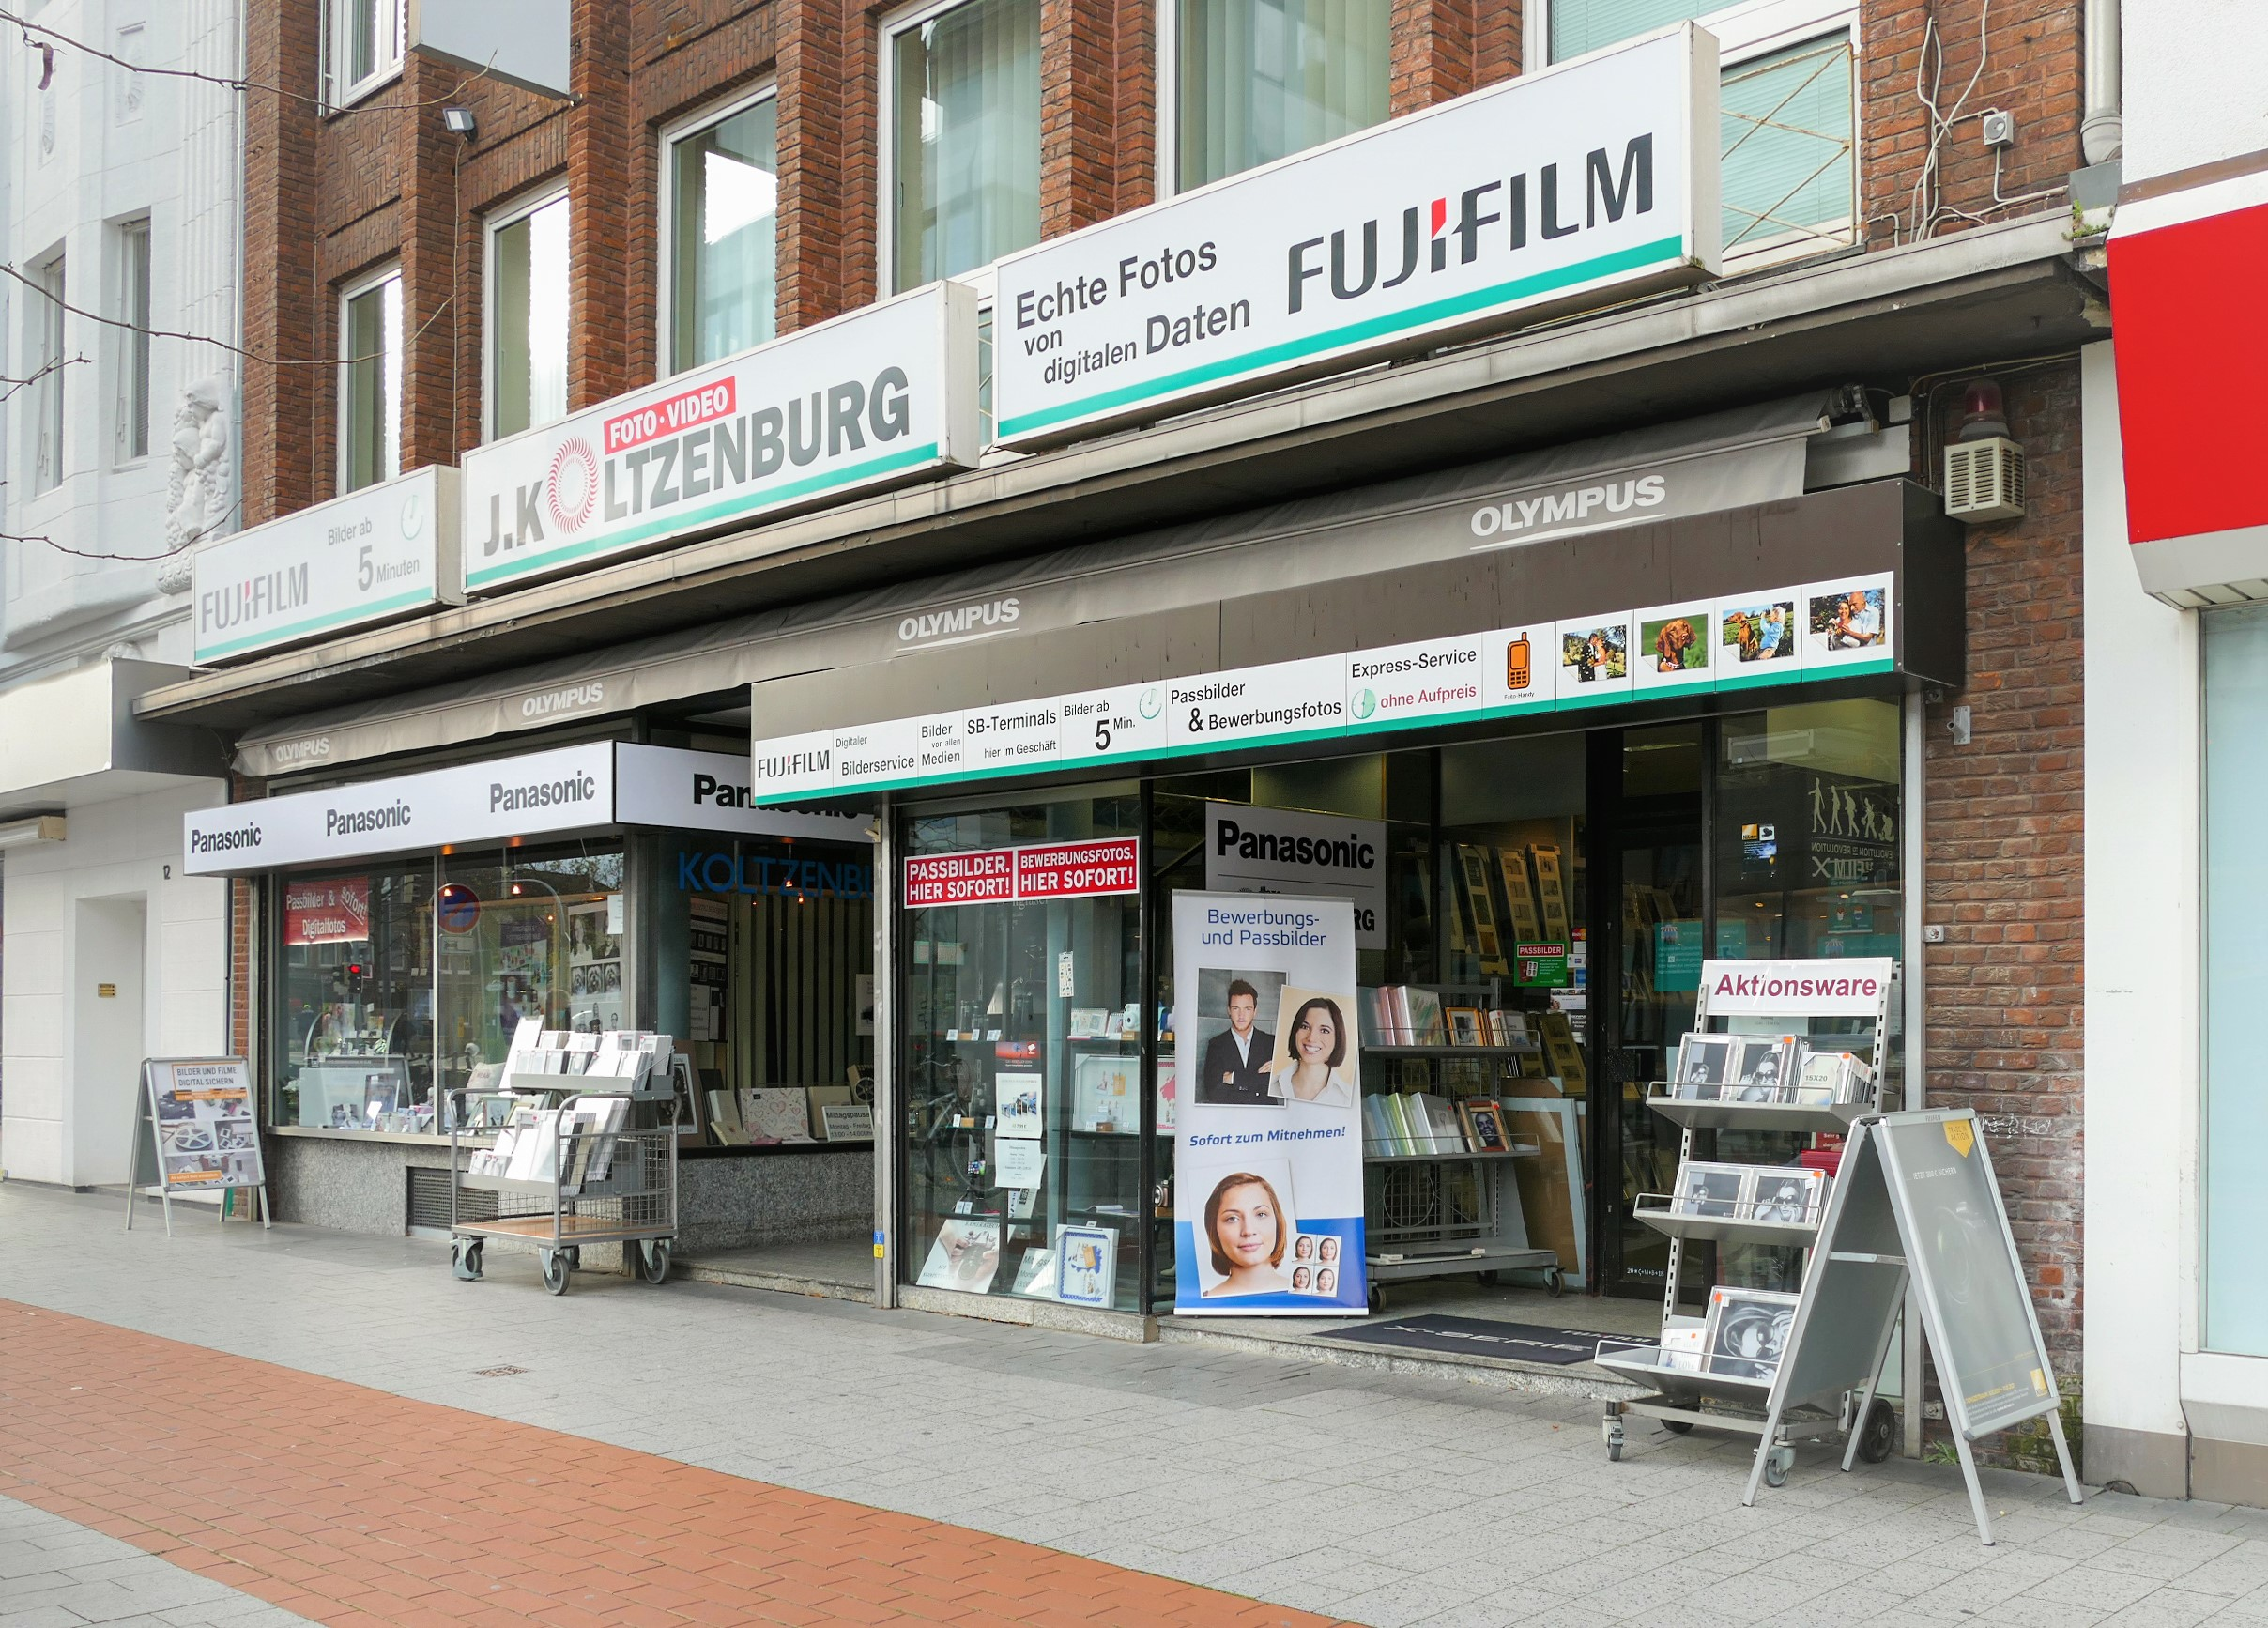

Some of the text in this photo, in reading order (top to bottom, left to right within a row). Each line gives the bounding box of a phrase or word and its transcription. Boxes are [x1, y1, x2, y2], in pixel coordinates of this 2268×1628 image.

[1288, 132, 1653, 315] FUJIFILM
[1017, 242, 1217, 330] Echte Fotos
[1024, 330, 1062, 356] von
[1044, 299, 1249, 384] digitalen Daten
[1470, 475, 1666, 537] OLYMPUS
[328, 518, 373, 547] Bilder ab
[357, 545, 421, 591] 5 Minuten
[201, 561, 309, 634] FUJIFILM
[898, 598, 1019, 641] OLYMPUS
[1352, 648, 1477, 680] Express-Service
[522, 683, 604, 717] OLYMPUS
[1171, 682, 1246, 705] Passbilder
[1380, 683, 1477, 709] ohne Aufpreis
[967, 708, 1057, 735] SB-Terminals
[1065, 700, 1110, 717] Bilder ab
[1188, 700, 1342, 732] & Bewerbungsfotos
[835, 735, 868, 749] Digitaler
[922, 723, 953, 738] Bilder
[931, 737, 961, 748] von allen
[1096, 716, 1136, 751] 5 Min.
[275, 737, 330, 763] OLYMPUS
[922, 750, 960, 766] Medien
[984, 740, 1057, 759] hier im Geschäft
[758, 750, 830, 778] FUJIFILM
[841, 755, 915, 776] Bilderservice
[490, 770, 595, 813] Panasonic
[327, 799, 411, 836] Panasonic
[191, 822, 262, 854] Panasonic
[1218, 819, 1375, 870] Panasonic
[910, 855, 1010, 882] PASSBILDER.
[1020, 847, 1134, 868] BEWERBUNGSFOTOS.
[910, 877, 1010, 901] HIER SOFORT!
[1020, 866, 1134, 892] HIER SOFORT!
[286, 890, 336, 911] Passbilder &
[302, 919, 346, 939] Digitalfotos
[1207, 909, 1320, 929] Bewerbungs-
[1202, 929, 1326, 946] und Passbilder
[1520, 946, 1562, 955] PASSBILDER
[1715, 973, 1877, 997] Aktionsware
[177, 1066, 237, 1076] BILDER UND FILME
[178, 1077, 234, 1086] DIGITAL SICHERN
[1805, 1074, 1828, 1083] 15X20
[1189, 1126, 1346, 1147] Sofort zum Mitnehmen!
